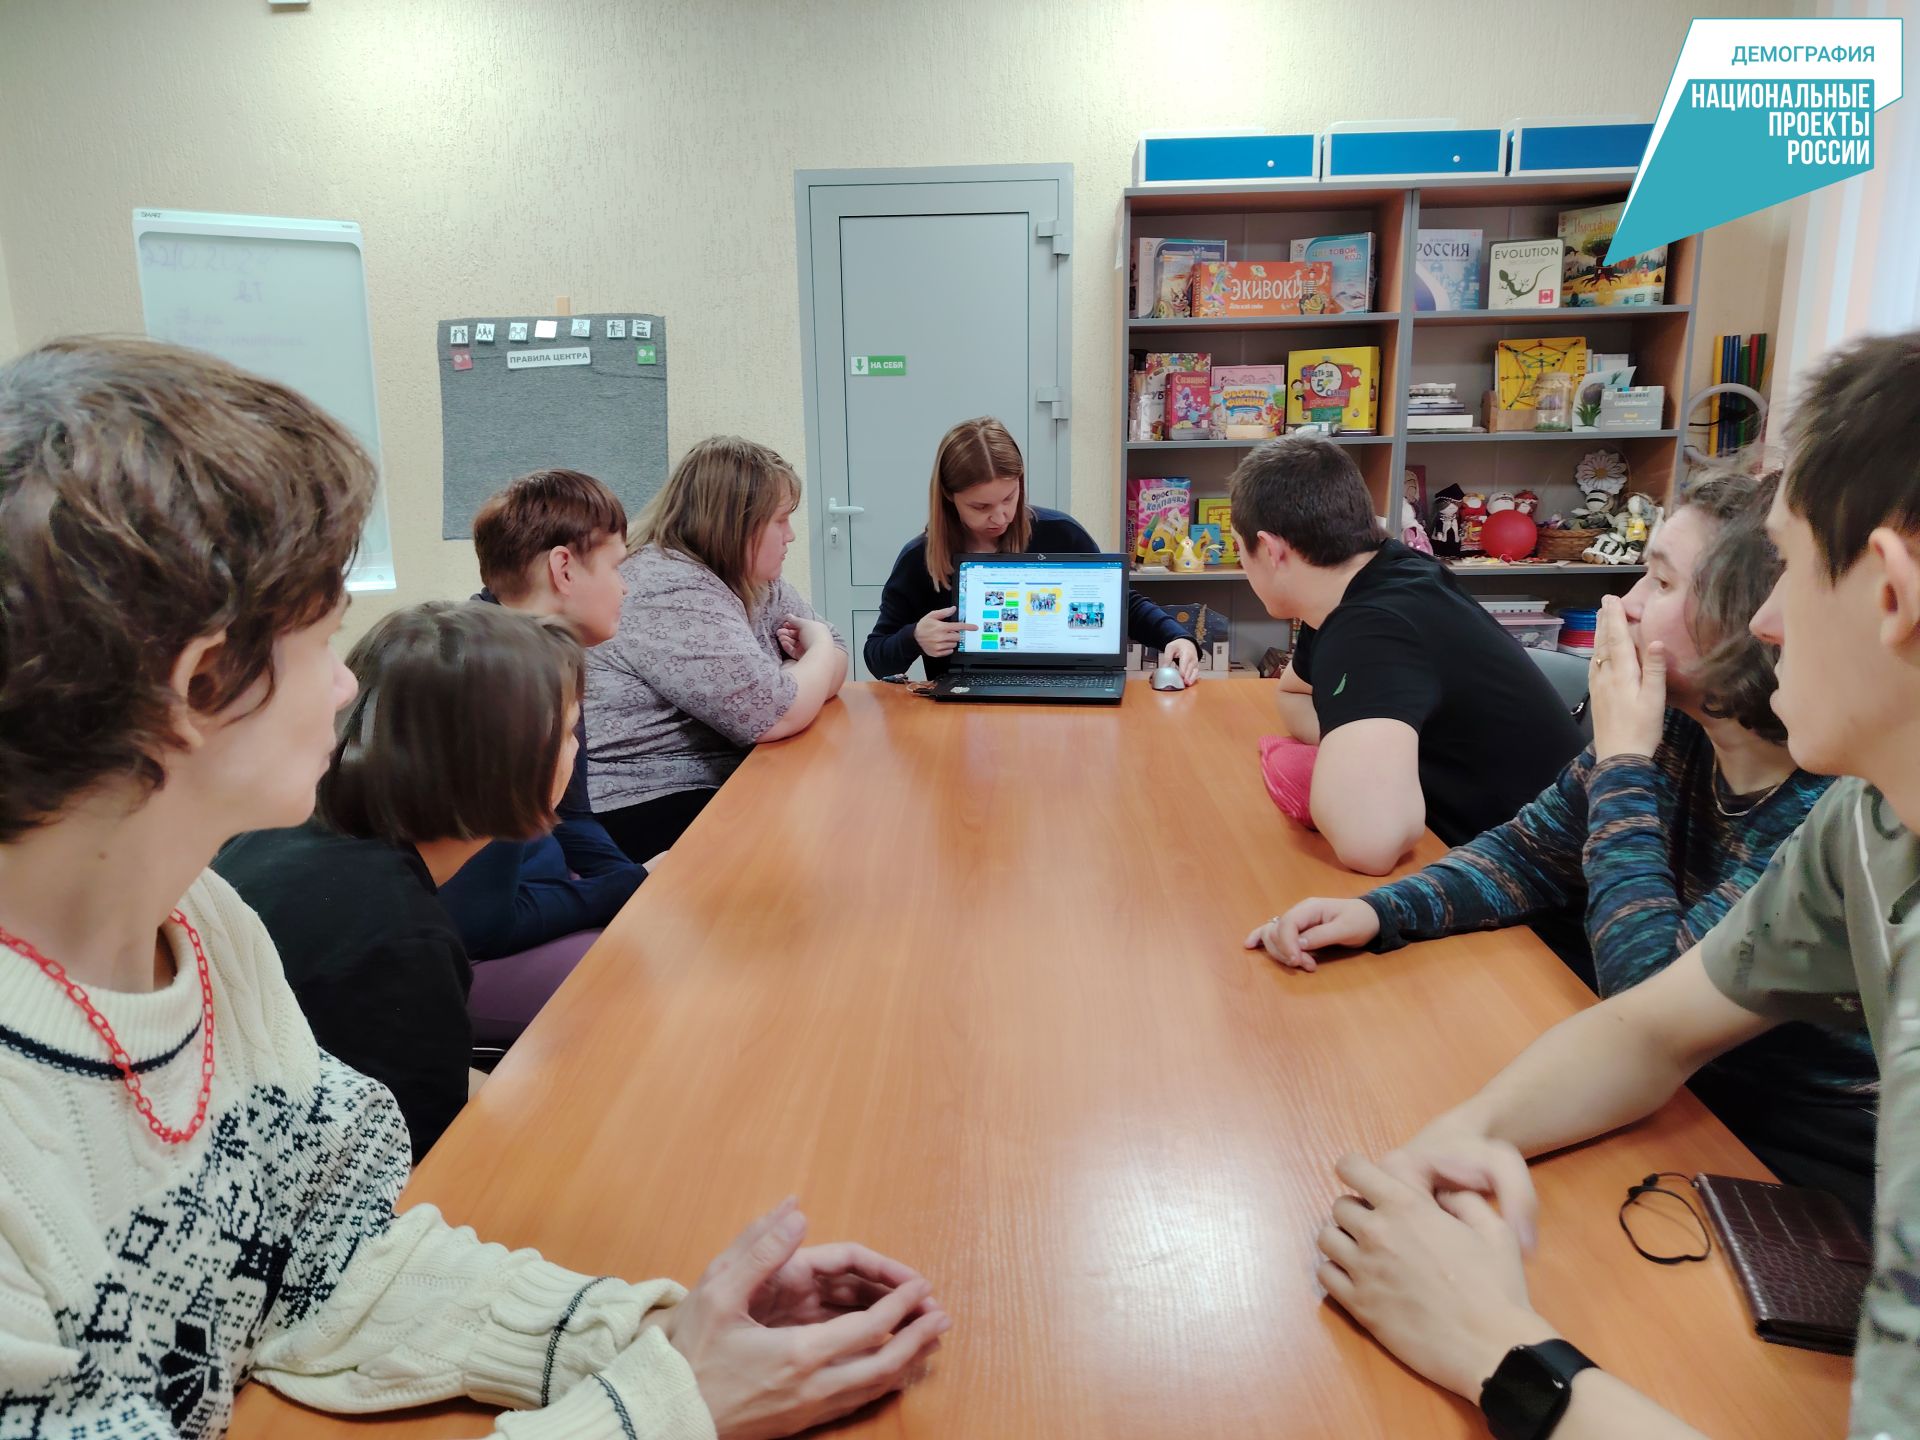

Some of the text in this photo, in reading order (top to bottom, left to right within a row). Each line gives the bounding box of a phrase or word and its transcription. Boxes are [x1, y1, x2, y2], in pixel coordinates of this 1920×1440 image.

[1494, 246, 1559, 260] EVOLUTION
[1230, 278, 1303, 301] ЭКИВОКИ
[509, 352, 588, 364] ПРАВИЛА ЦЕНТРА
[870, 361, 904, 369] НА СЕБЯ
[1316, 378, 1325, 393] 5
